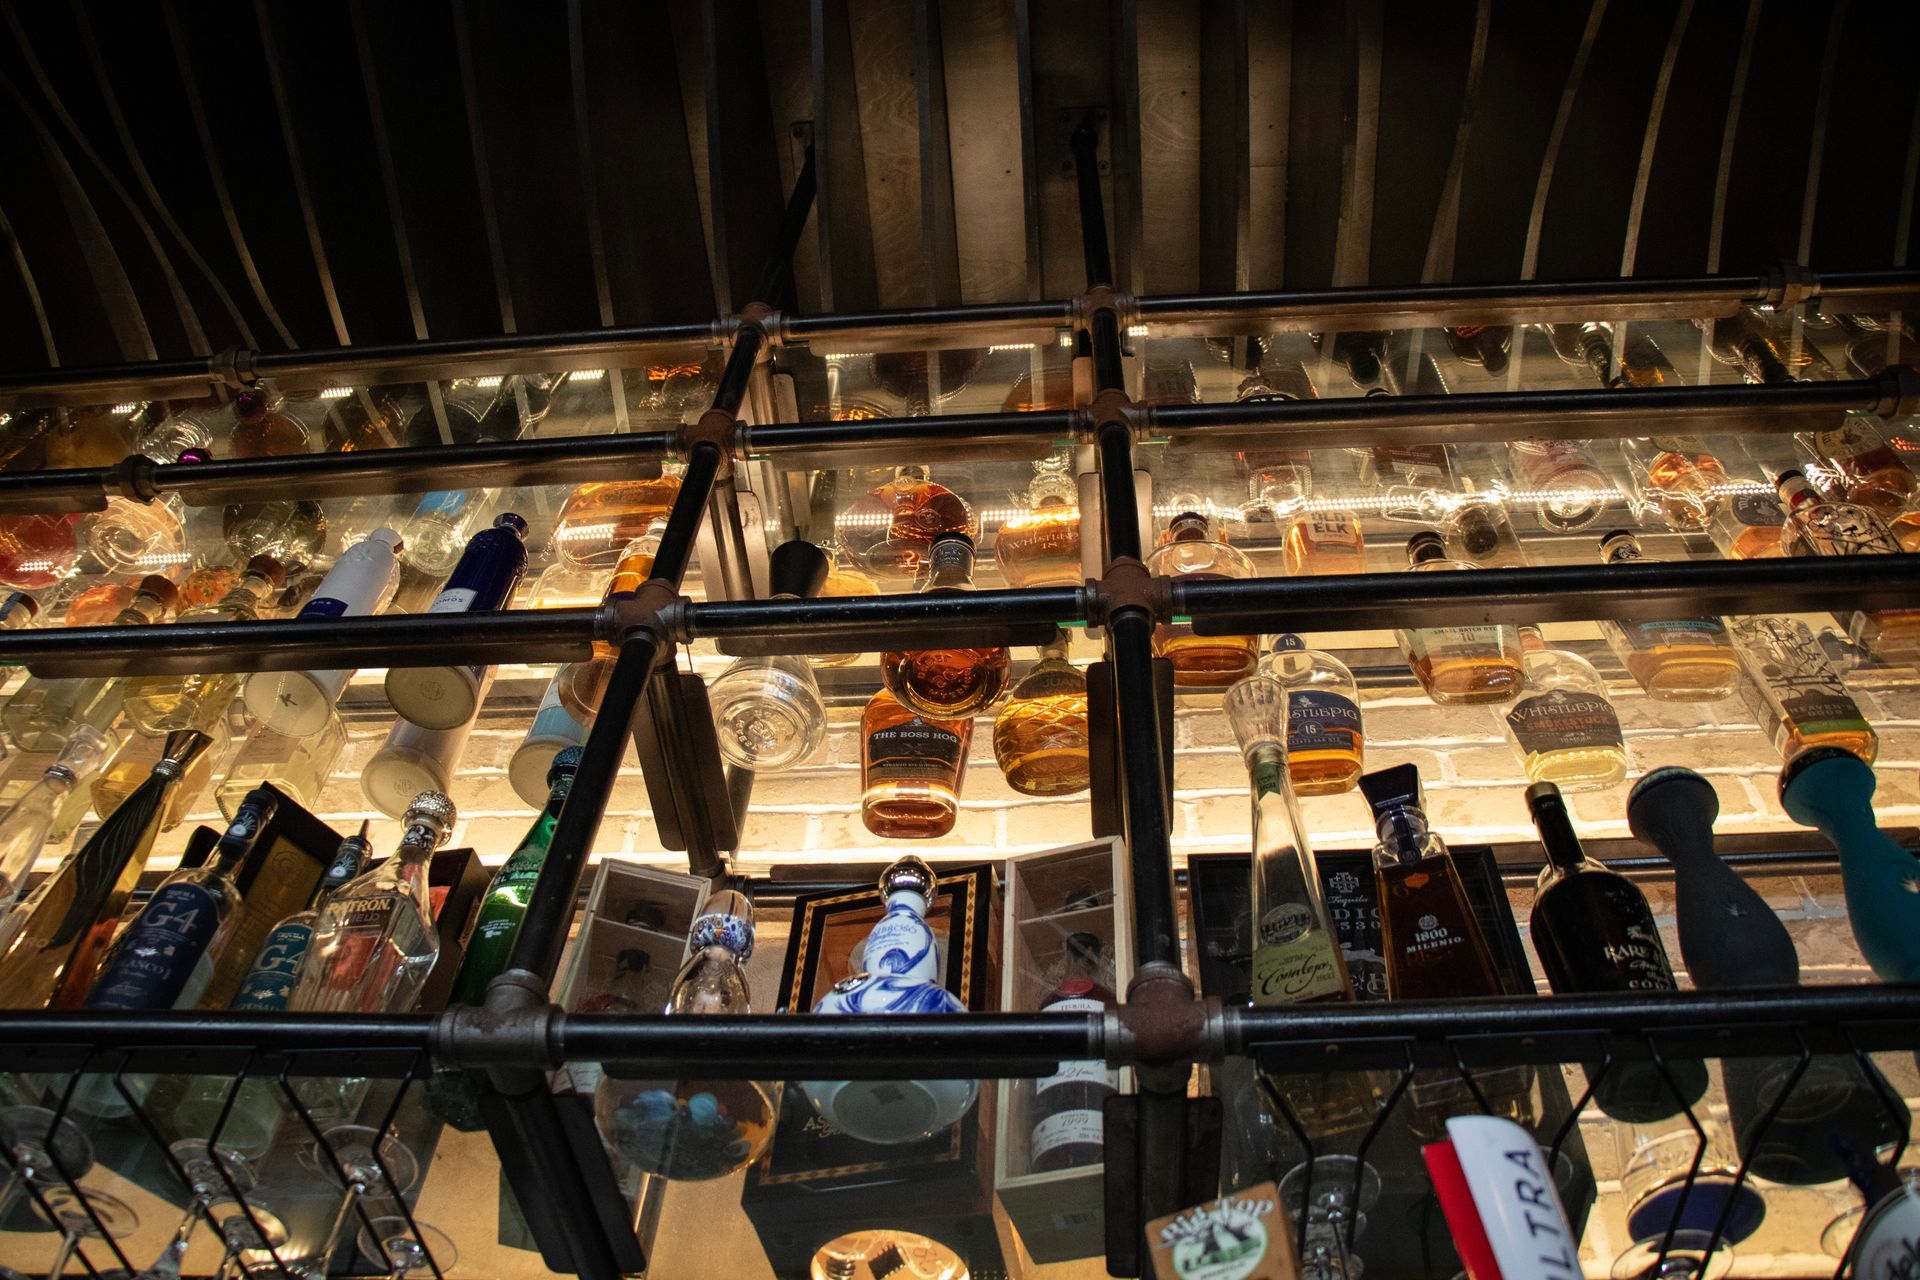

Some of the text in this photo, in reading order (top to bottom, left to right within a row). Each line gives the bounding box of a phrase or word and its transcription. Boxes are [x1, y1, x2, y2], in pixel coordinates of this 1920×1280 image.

[1313, 523, 1349, 534] ELK
[1285, 638, 1296, 646] 15
[1509, 701, 1615, 723] WHISTLEPIG
[1305, 724, 1317, 734] 15
[874, 731, 958, 743] THE BOSS HOG
[141, 901, 199, 934] G4
[1414, 928, 1448, 942] 1800
[1214, 1196, 1274, 1220] Top
[1504, 1150, 1574, 1280] LTRA
